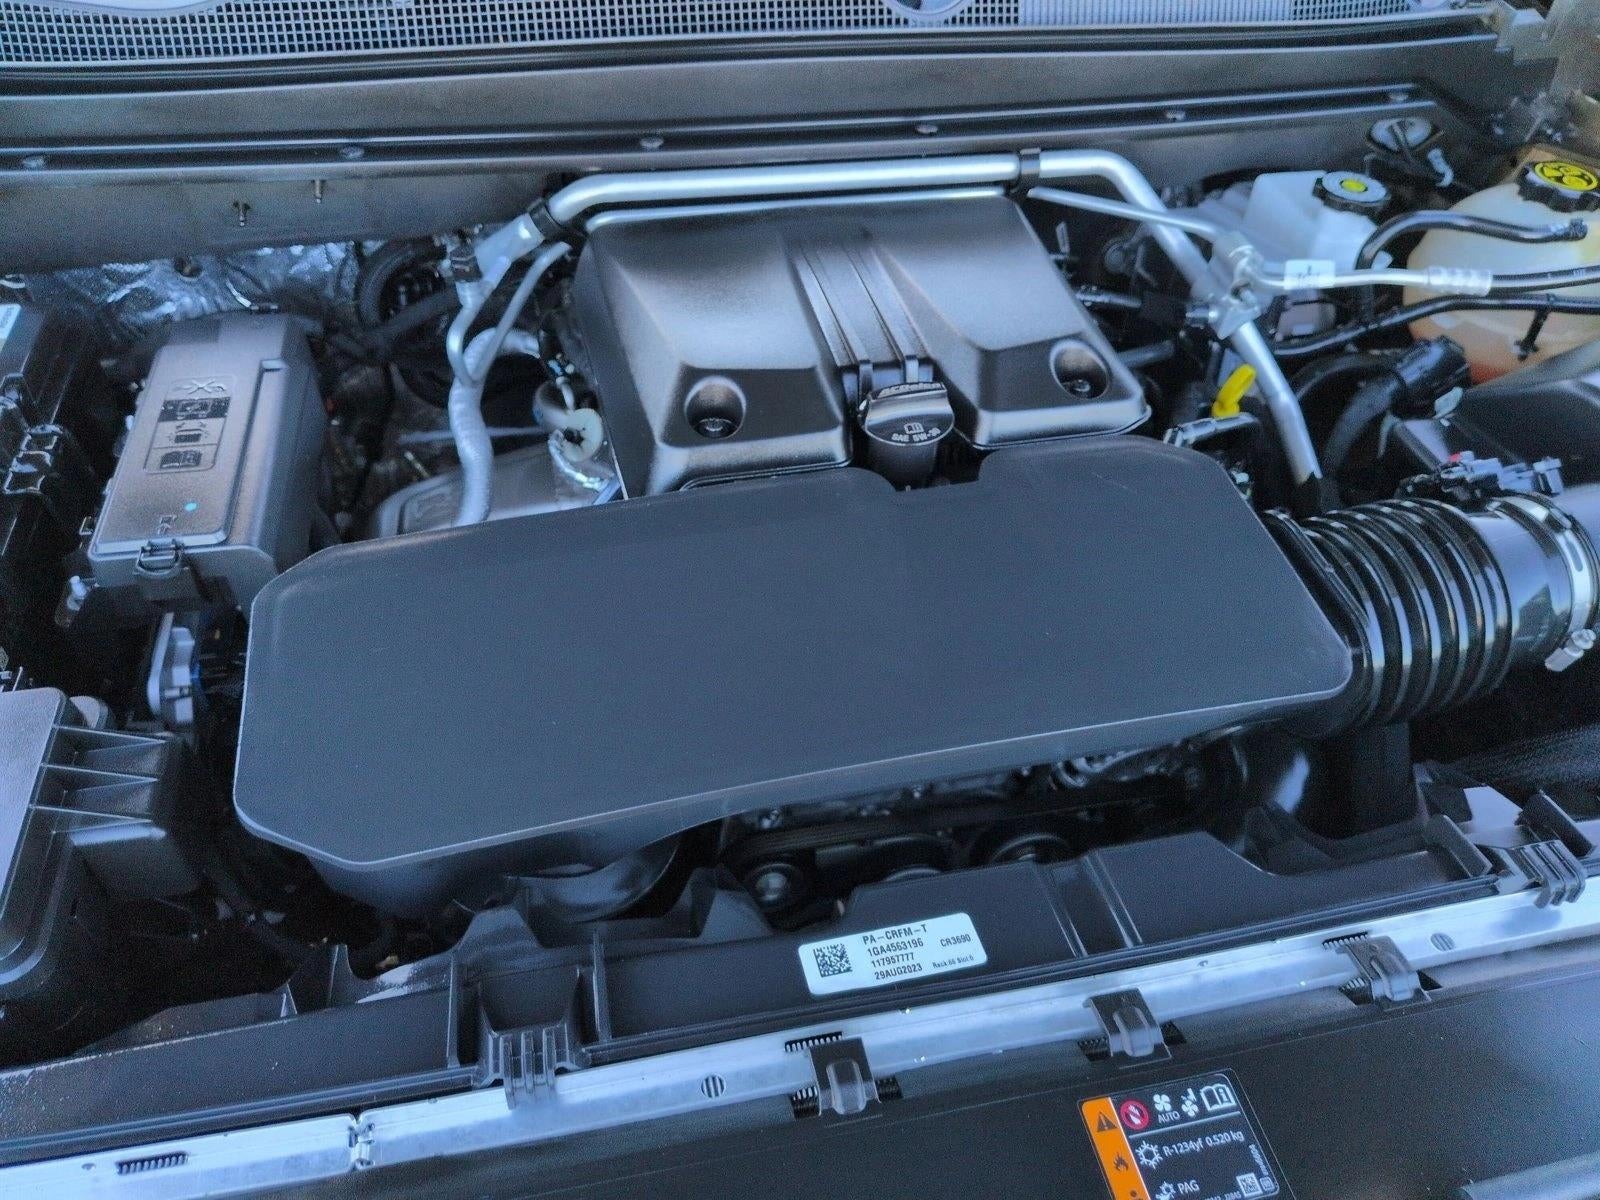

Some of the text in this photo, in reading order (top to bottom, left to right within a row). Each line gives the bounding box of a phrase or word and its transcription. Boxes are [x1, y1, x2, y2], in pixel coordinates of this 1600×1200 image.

[868, 937, 924, 957] 1GA4563196
[940, 933, 971, 947] CR3690
[871, 952, 914, 968] 117957777
[874, 963, 922, 980] 29AUG2023
[1158, 1110, 1180, 1124] AUTO
[1162, 1130, 1245, 1157] R-1234yf 0.520 kg
[1177, 1180, 1200, 1195] PAG
